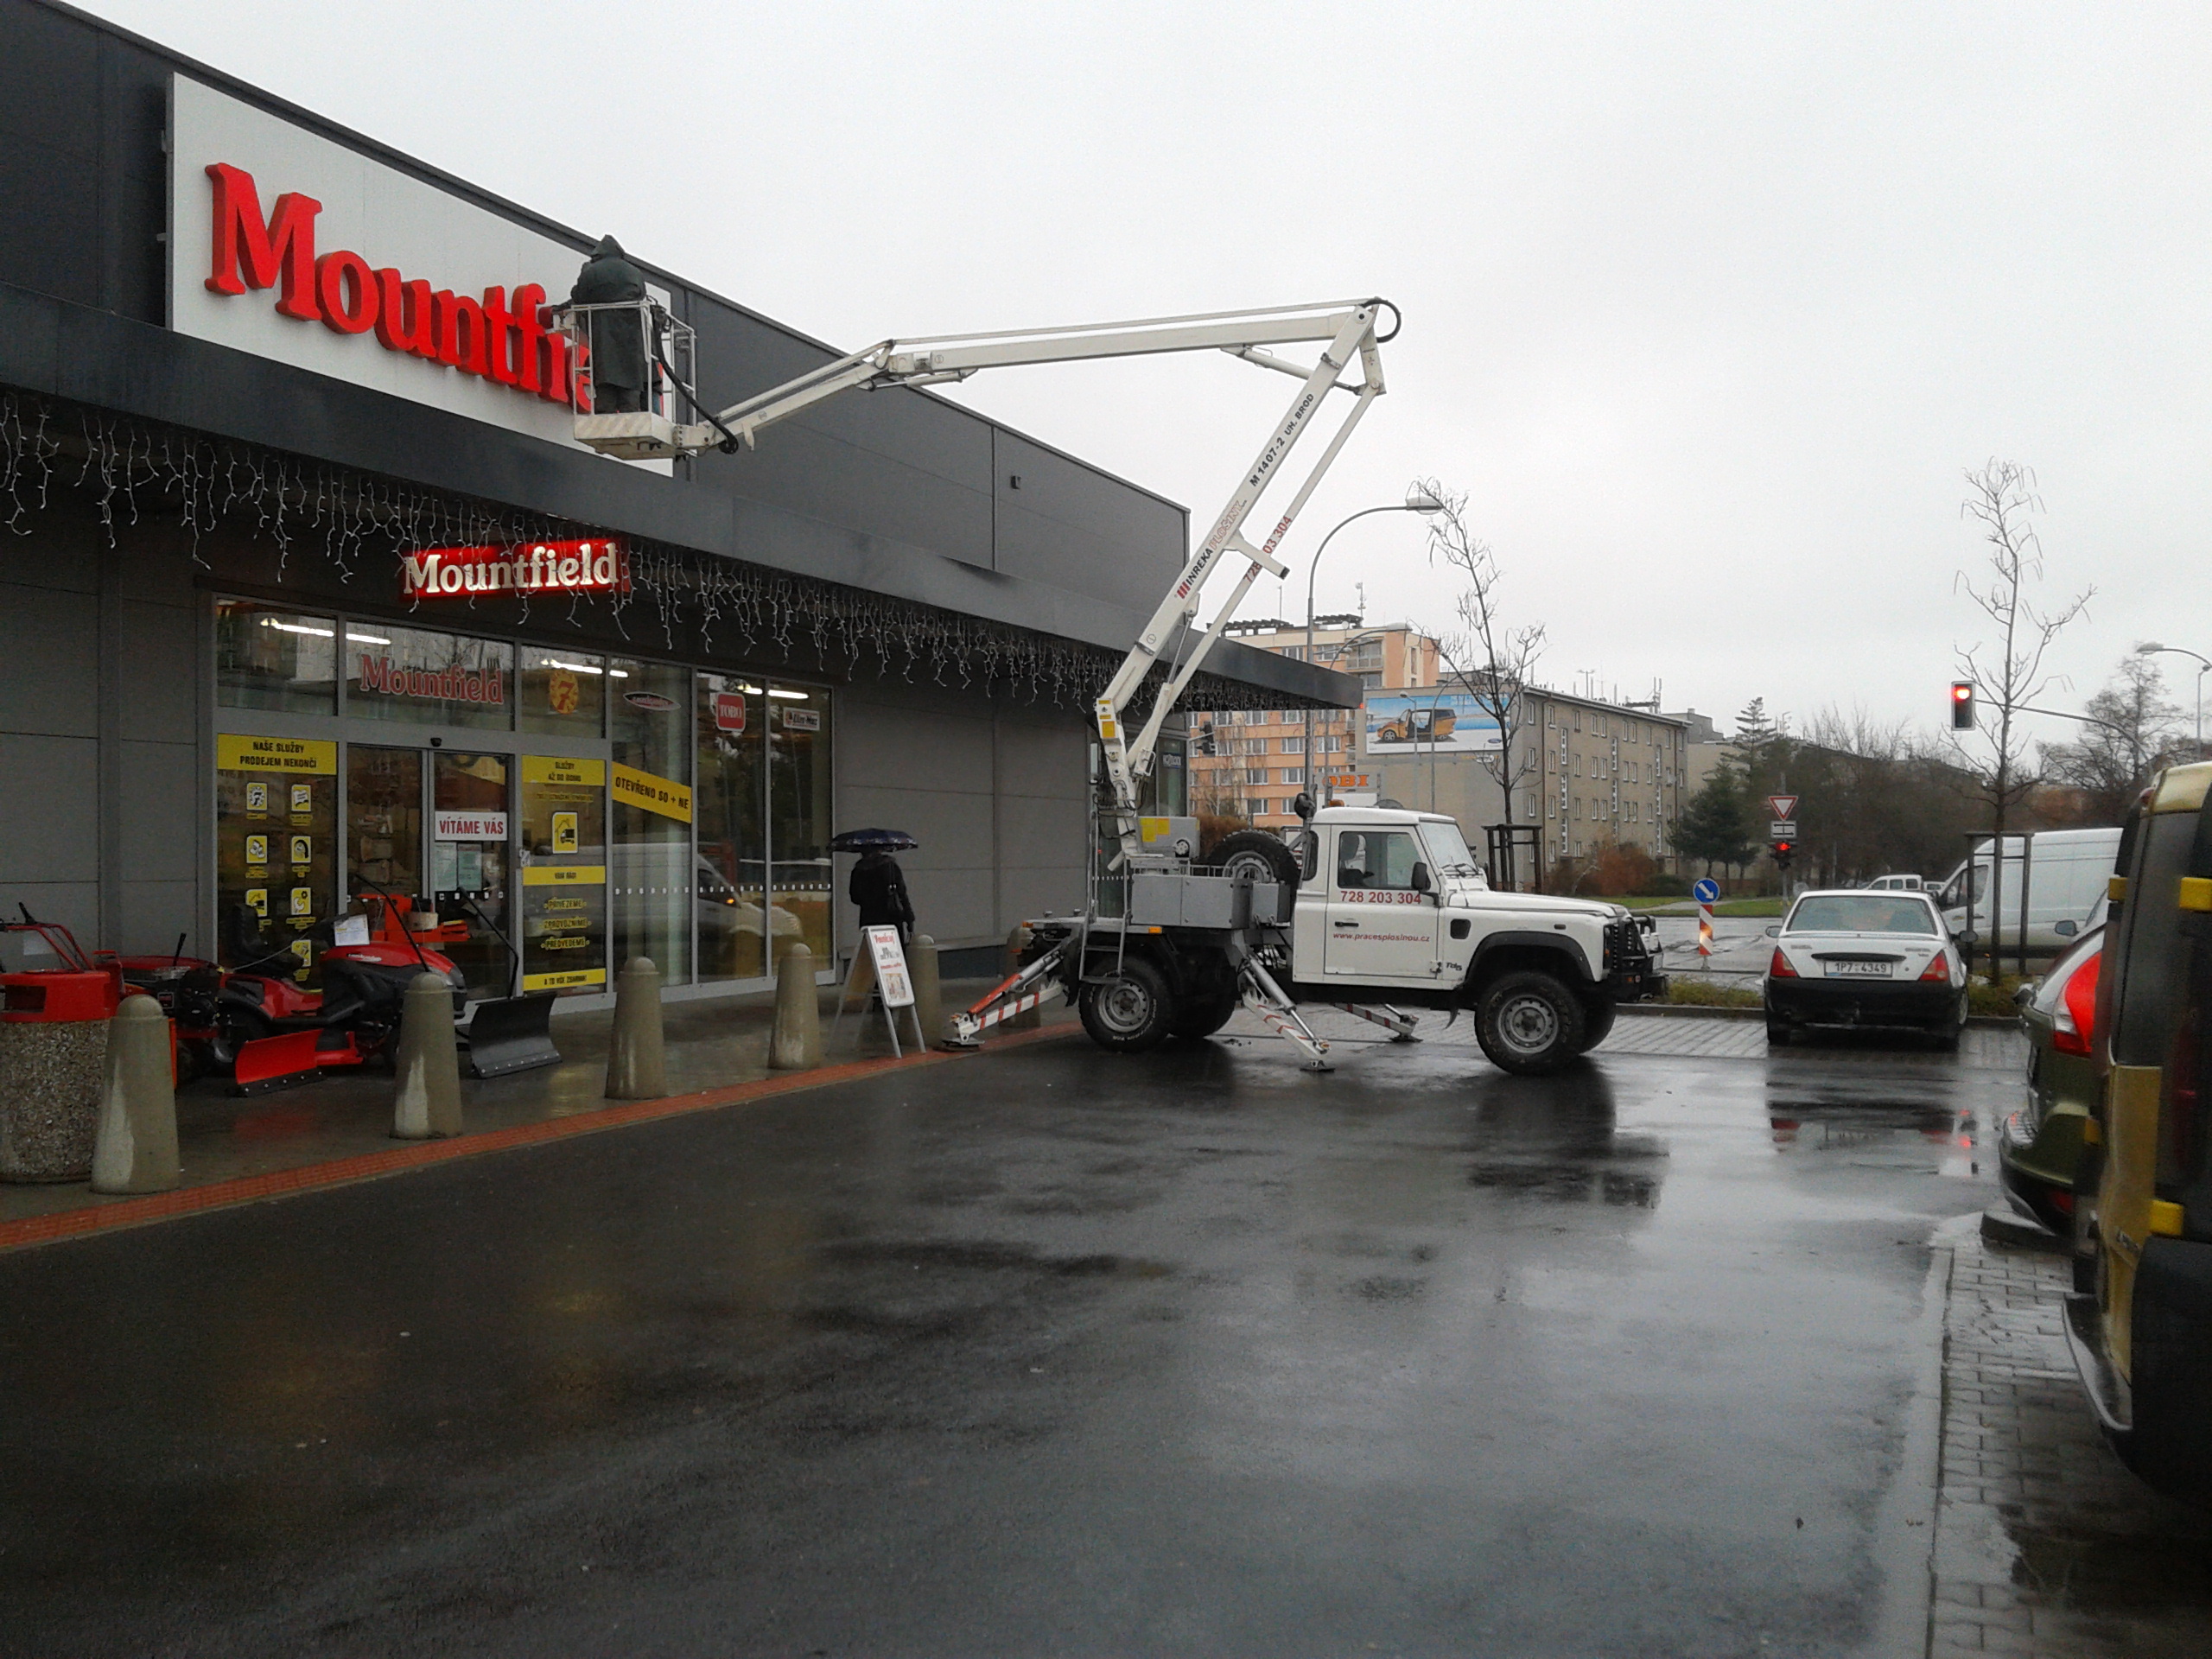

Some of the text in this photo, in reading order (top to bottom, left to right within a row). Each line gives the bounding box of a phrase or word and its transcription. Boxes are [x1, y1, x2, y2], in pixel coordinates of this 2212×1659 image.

[1249, 393, 1314, 487] M 1407-2 UH. BROD
[1243, 515, 1292, 583] 728 03 304
[403, 542, 620, 594] Mountfield
[1185, 547, 1214, 586] INREKA
[359, 653, 505, 705] Mountfield
[719, 704, 742, 719] TORO
[252, 741, 305, 753] NAŠE SLUŽBY
[239, 756, 317, 768] PRODEJEM NEKONČÍ
[1321, 774, 1370, 787] OBI
[615, 776, 656, 799] OTEVŘENO
[658, 790, 669, 804] SO
[678, 797, 689, 810] NE
[439, 816, 504, 835] VÍTÁME VÁS
[1340, 890, 1422, 905] 728 203 304
[1834, 963, 1887, 974] 1P7 4349
